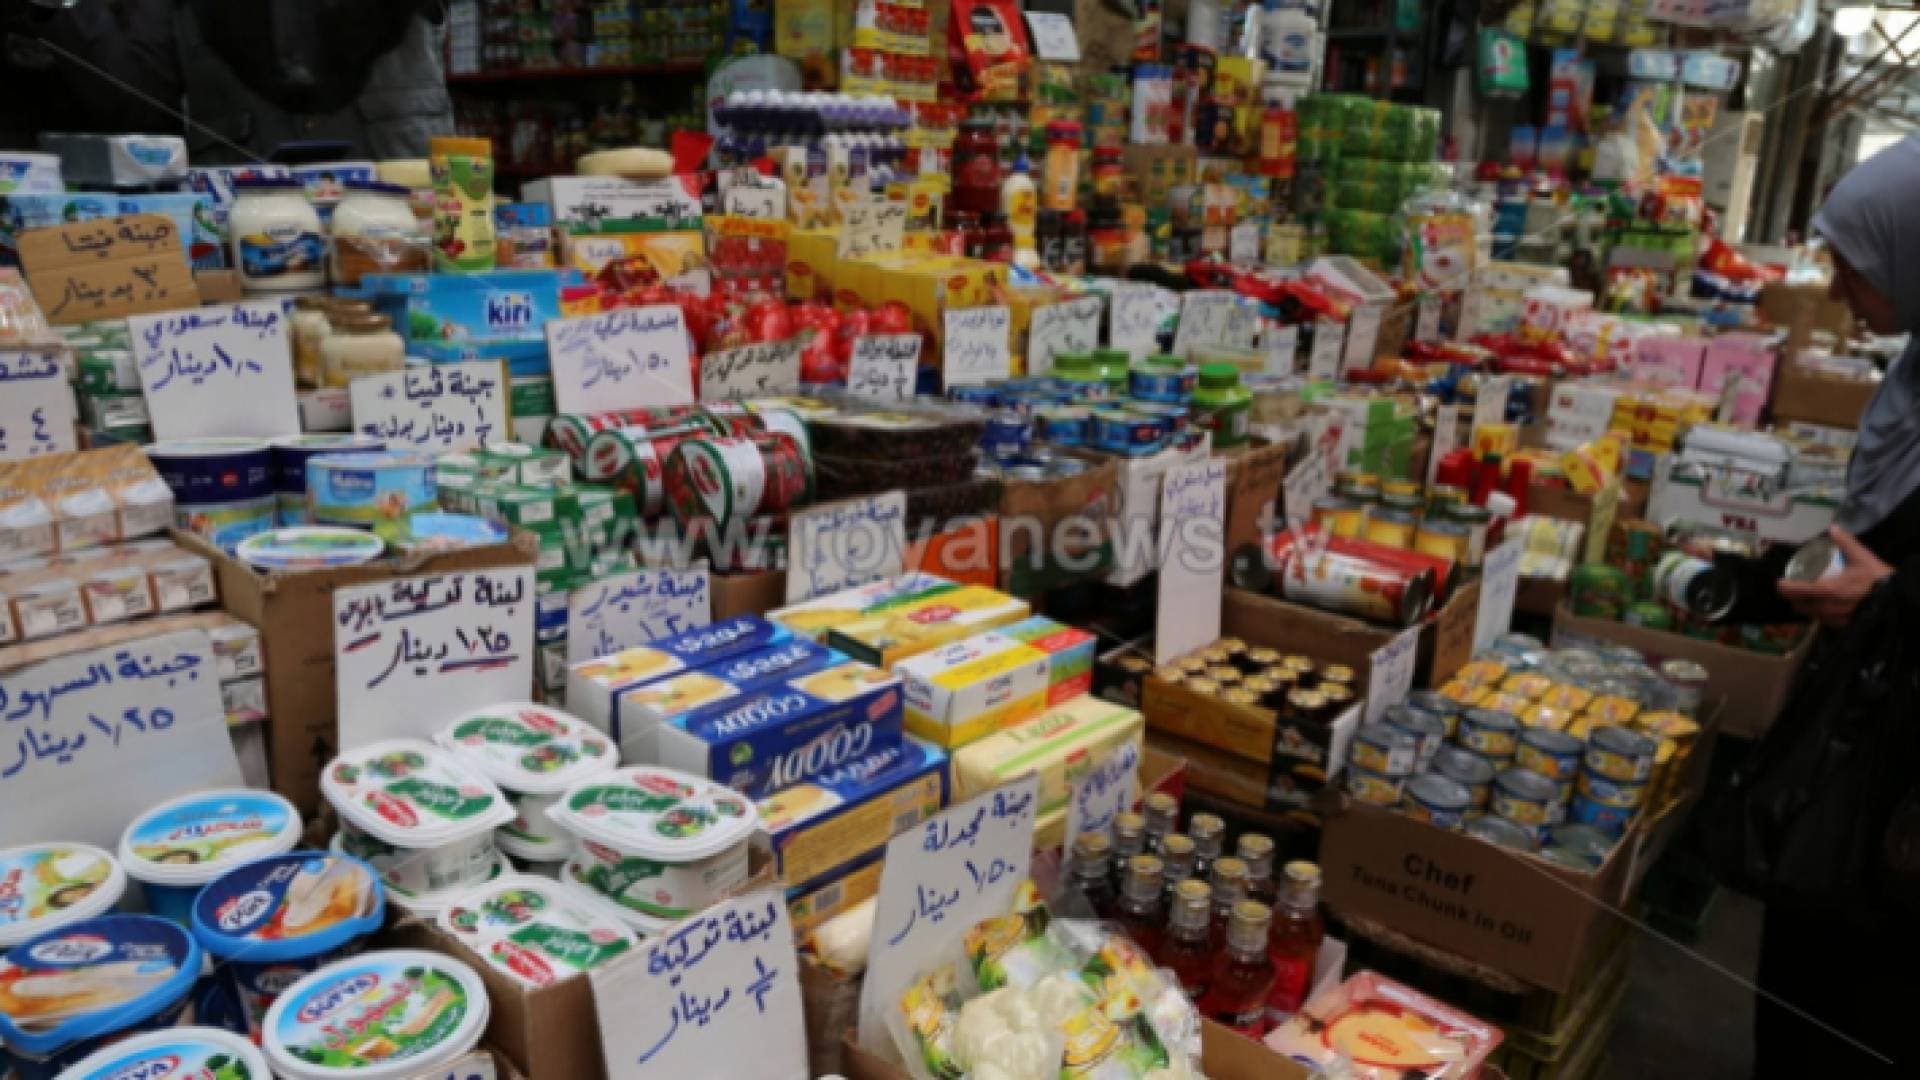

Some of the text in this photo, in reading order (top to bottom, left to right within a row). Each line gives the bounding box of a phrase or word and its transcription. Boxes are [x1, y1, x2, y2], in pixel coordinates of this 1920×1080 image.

[488, 294, 532, 326] kiri
[448, 370, 496, 406] جبنة
[473, 573, 525, 617] لبنة
[115, 650, 202, 688] جبنة
[365, 626, 449, 690] دينار
[1, 727, 88, 778] دينار
[1351, 865, 1398, 897] Tuna
[1402, 883, 1468, 920] Chunk
[1403, 852, 1476, 896] Chef
[722, 901, 779, 943] لبنة
[888, 885, 960, 946] دينار
[636, 986, 732, 1065] دينار
